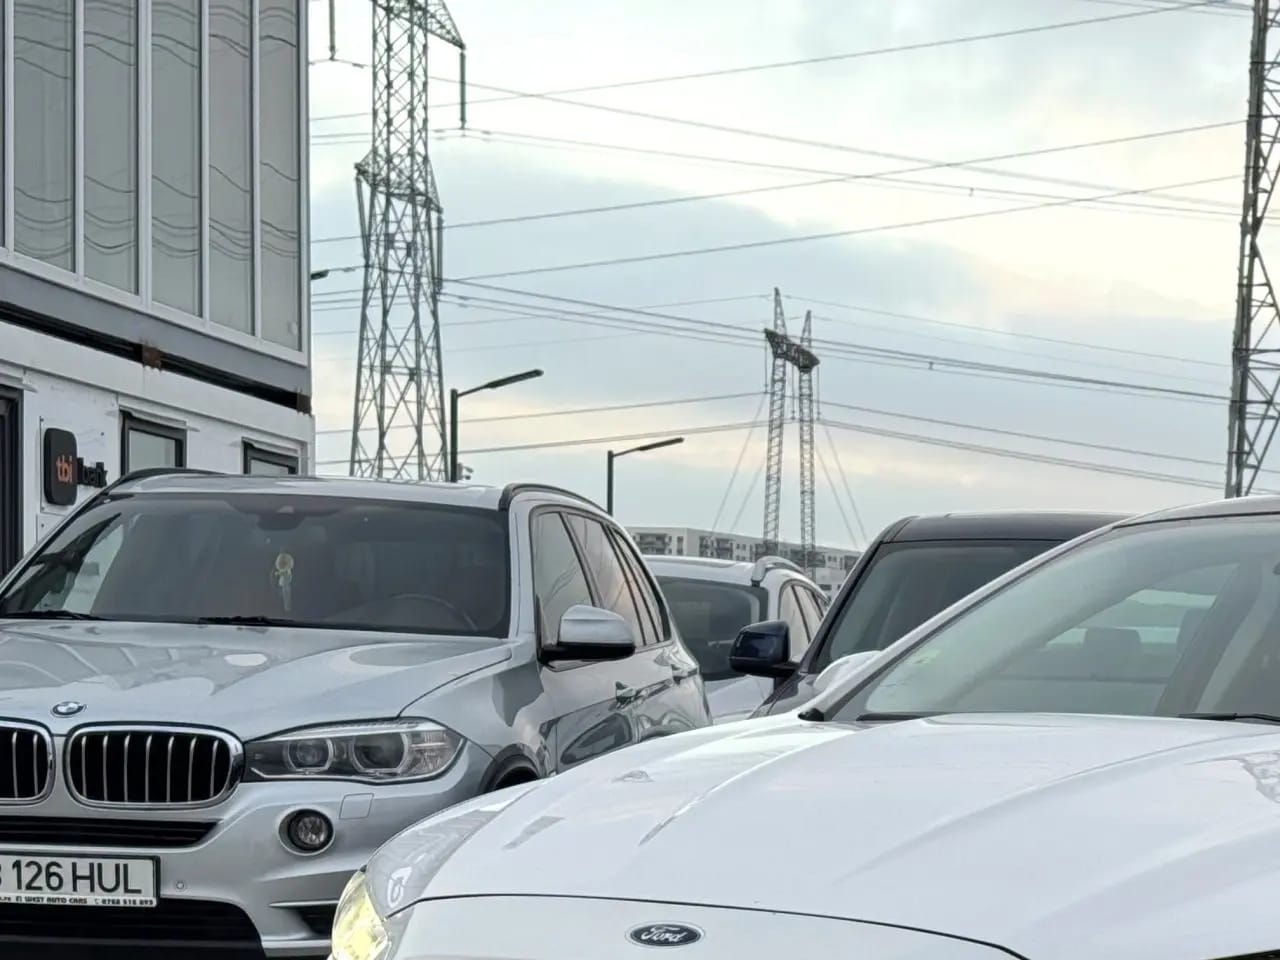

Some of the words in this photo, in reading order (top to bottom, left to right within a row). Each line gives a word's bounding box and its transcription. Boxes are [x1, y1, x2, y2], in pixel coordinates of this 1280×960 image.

[56, 454, 73, 484] tbi
[12, 859, 64, 891] 126
[71, 862, 142, 894] HUL
[25, 895, 44, 903] WEST
[47, 896, 67, 904] AUTO
[640, 925, 688, 943] Ford
